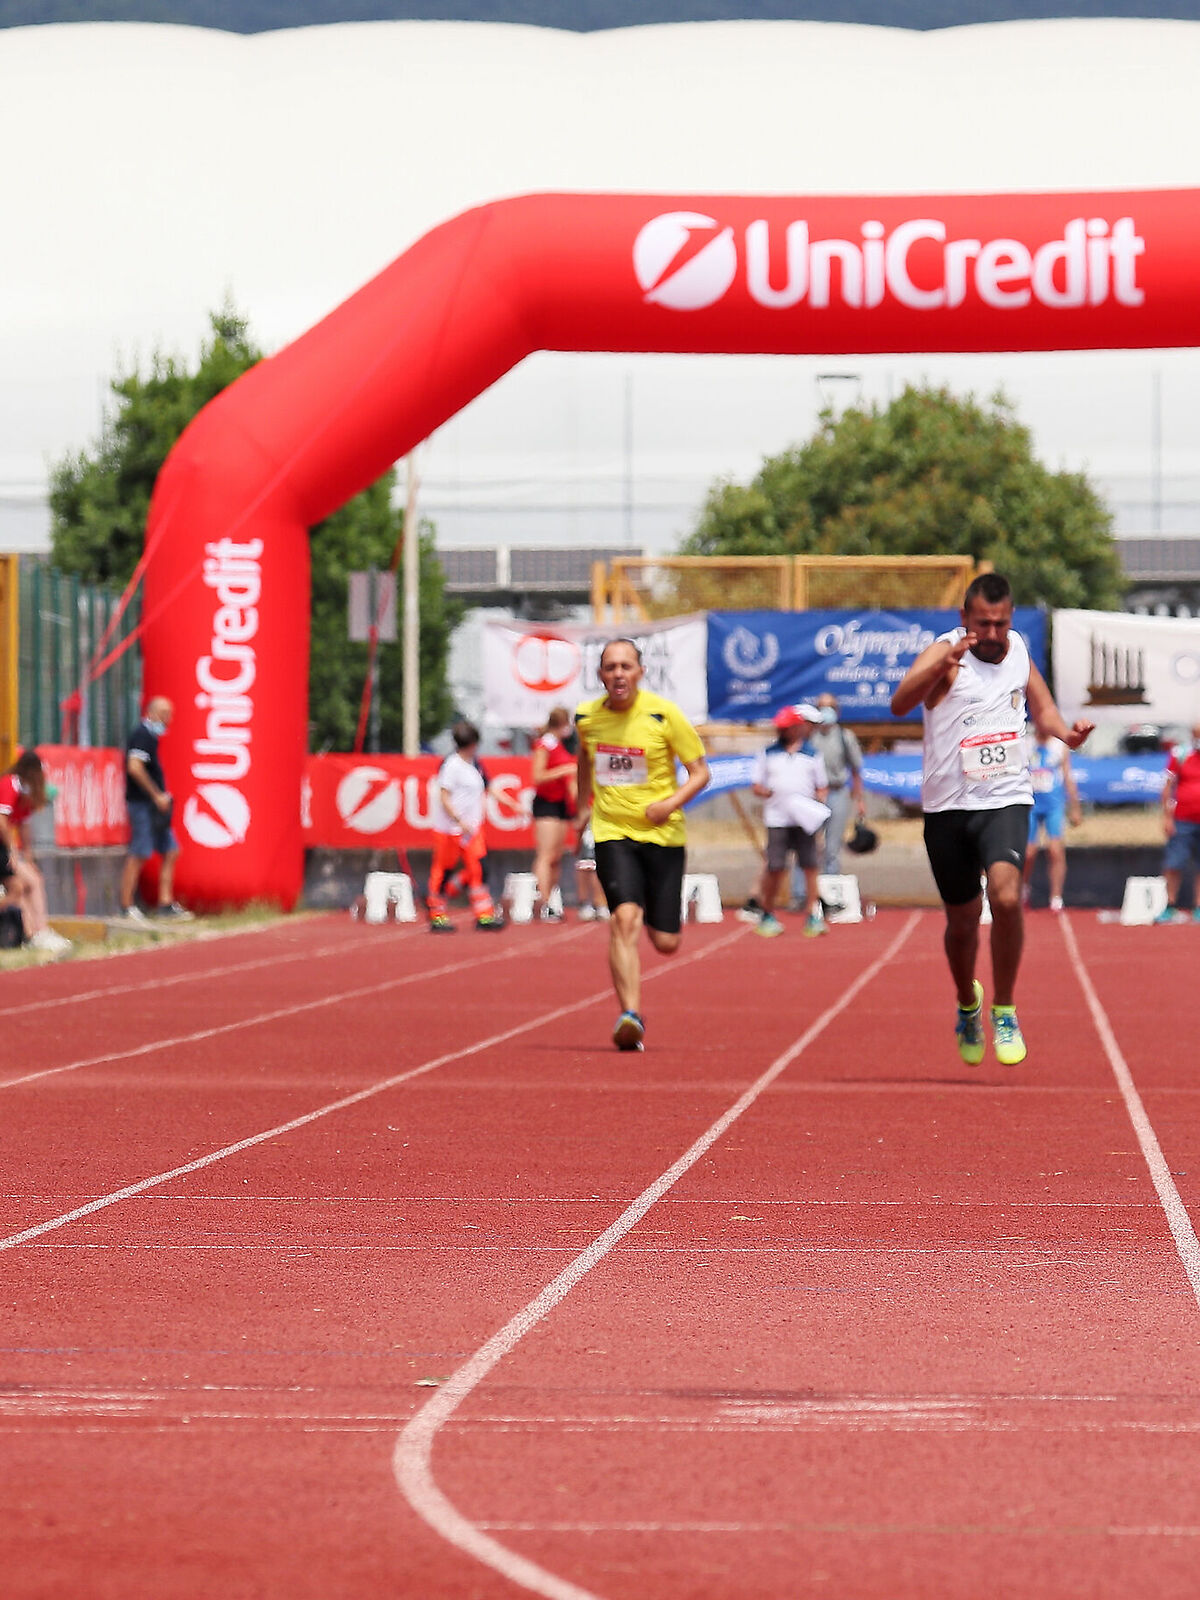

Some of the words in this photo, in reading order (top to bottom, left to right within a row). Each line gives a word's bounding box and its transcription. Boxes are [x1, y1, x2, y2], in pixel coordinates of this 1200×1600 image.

[745, 217, 1145, 308] UniCredit
[191, 537, 263, 780] UniCredit
[980, 745, 1006, 765] 83
